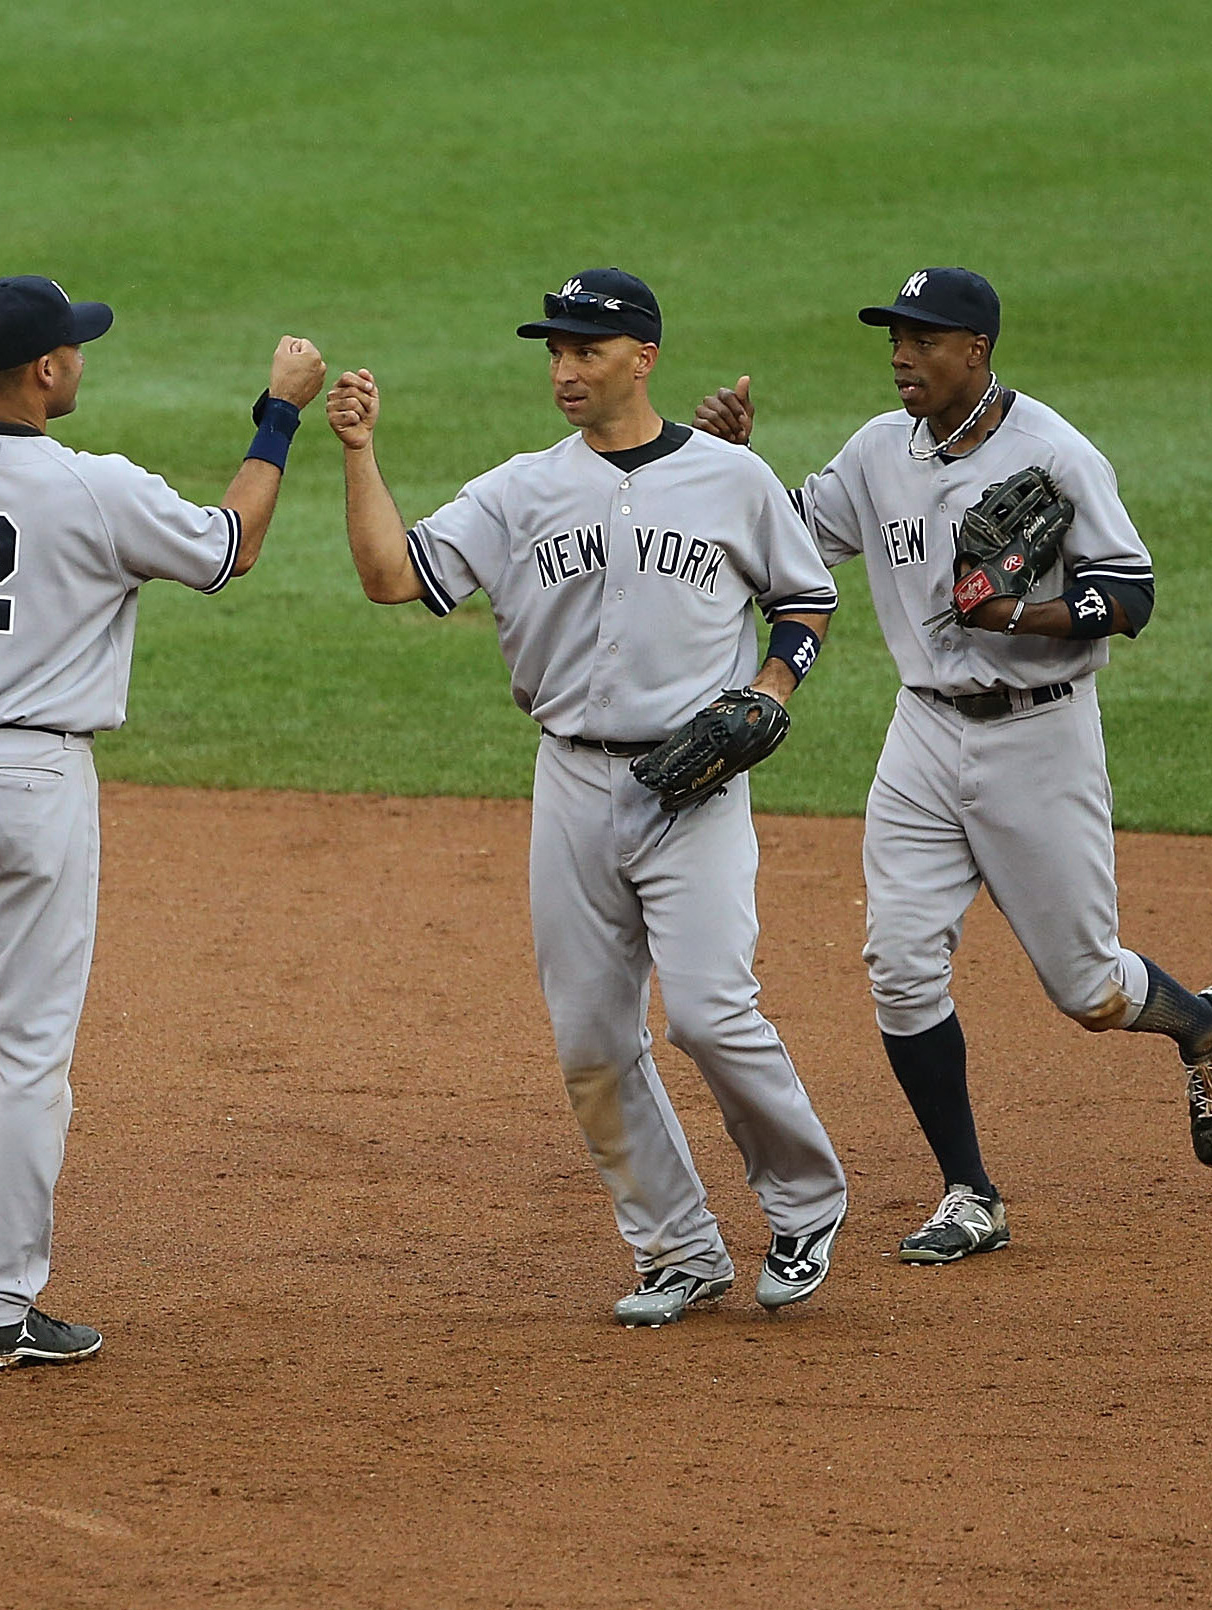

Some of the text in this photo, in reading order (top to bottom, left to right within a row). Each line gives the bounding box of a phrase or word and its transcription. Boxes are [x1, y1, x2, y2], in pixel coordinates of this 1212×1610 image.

[900, 271, 928, 297] NY
[534, 522, 726, 596] NEW YORK
[1074, 595, 1097, 619] 14
